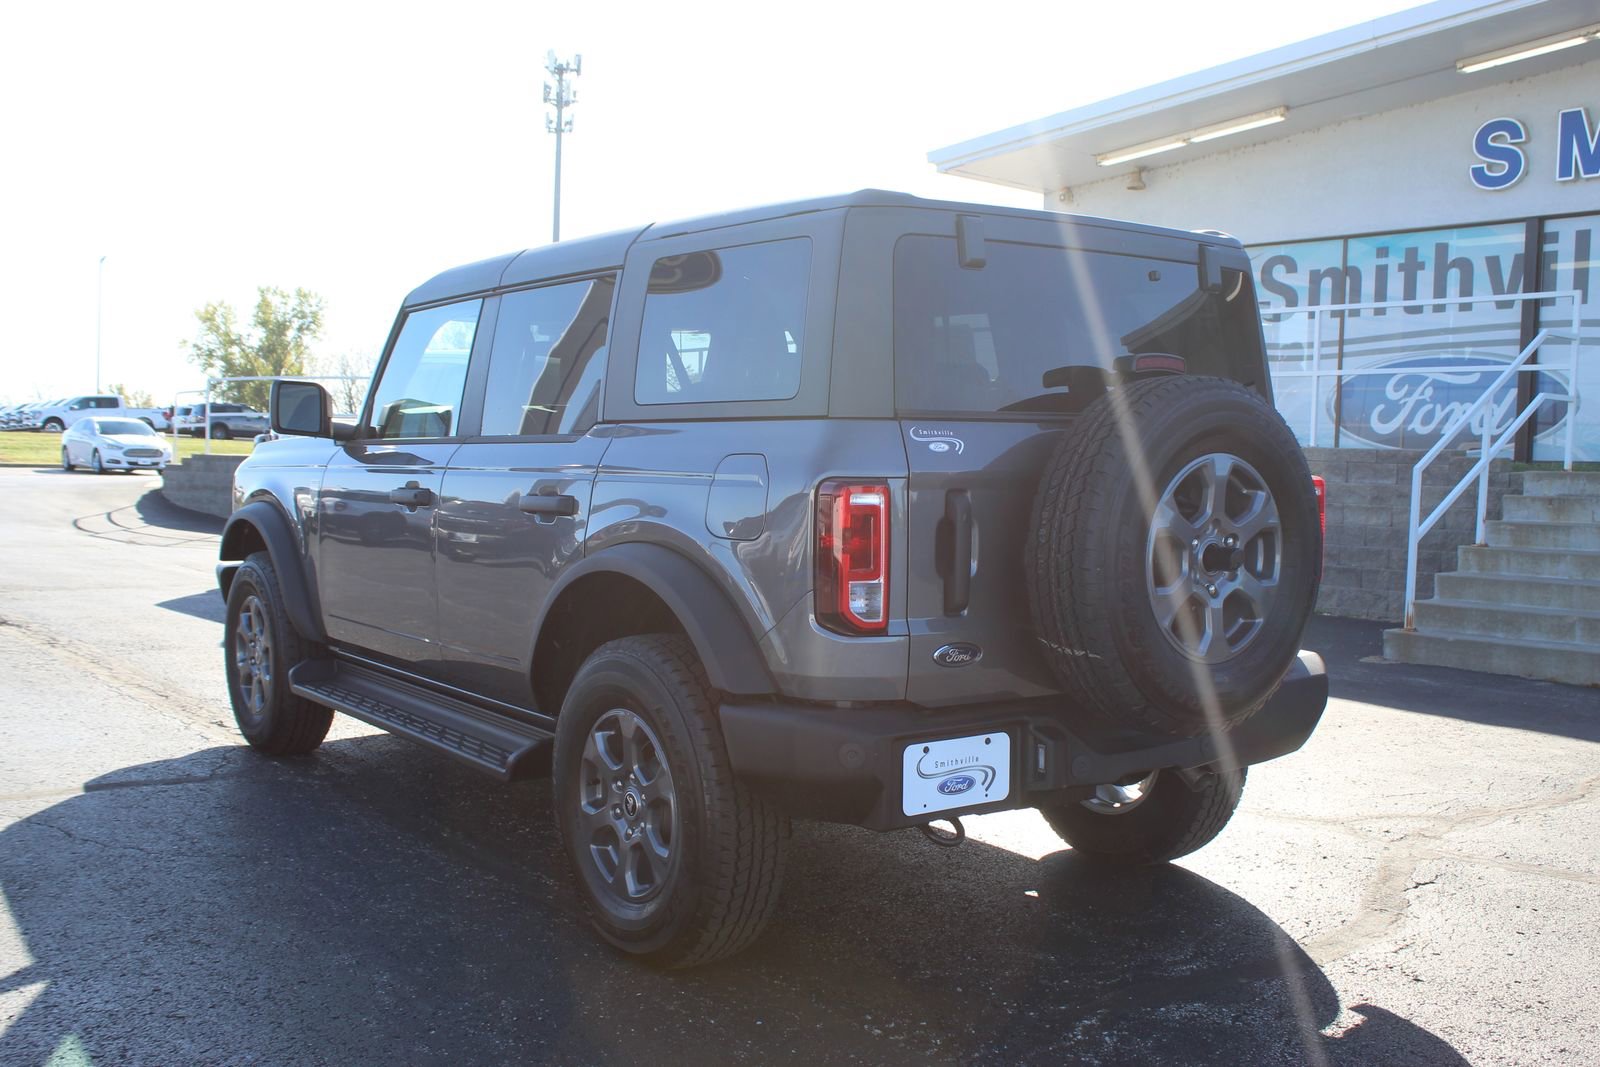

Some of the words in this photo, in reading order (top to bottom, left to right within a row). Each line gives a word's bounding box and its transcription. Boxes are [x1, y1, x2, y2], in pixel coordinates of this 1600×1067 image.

[1370, 372, 1519, 436] Ford
[946, 648, 972, 662] Ford
[934, 755, 979, 769] Smithville
[944, 777, 970, 792] Ford
